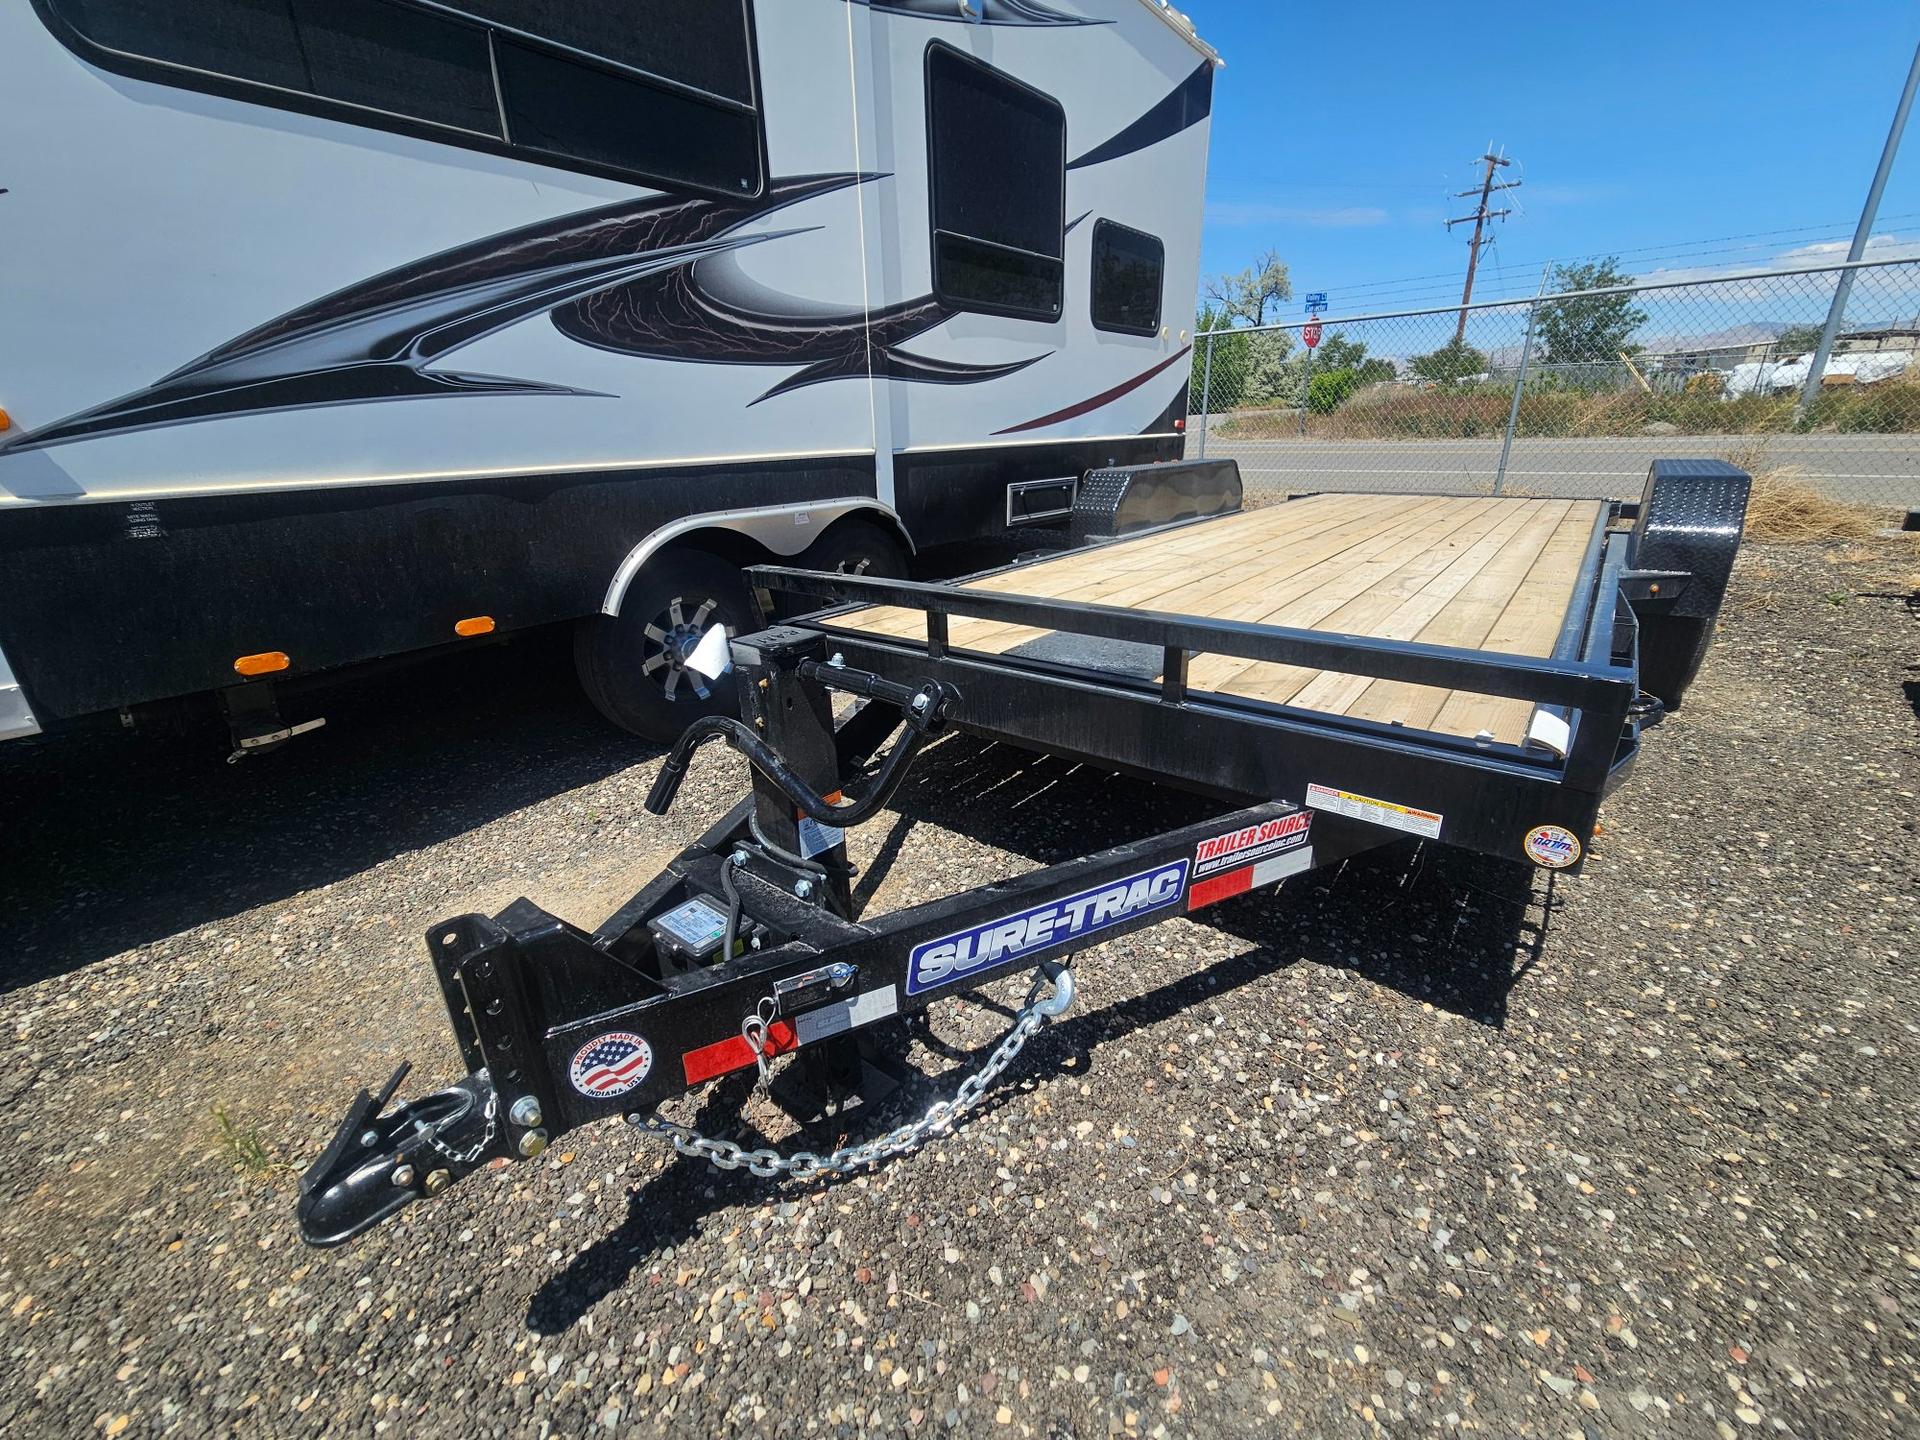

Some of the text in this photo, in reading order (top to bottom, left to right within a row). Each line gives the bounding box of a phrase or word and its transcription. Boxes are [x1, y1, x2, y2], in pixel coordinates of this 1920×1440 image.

[1304, 326, 1321, 339] STOP
[1315, 786, 1339, 797] DANGER
[1354, 796, 1379, 807] CAUTION
[1411, 810, 1439, 821] WARNING
[1197, 826, 1257, 860] TRAILER
[1257, 811, 1313, 842] SOURCE
[917, 868, 1180, 984] SURE-TRAC
[574, 1033, 644, 1065] PROUDLY MADE IN
[627, 1076, 642, 1088] USA
